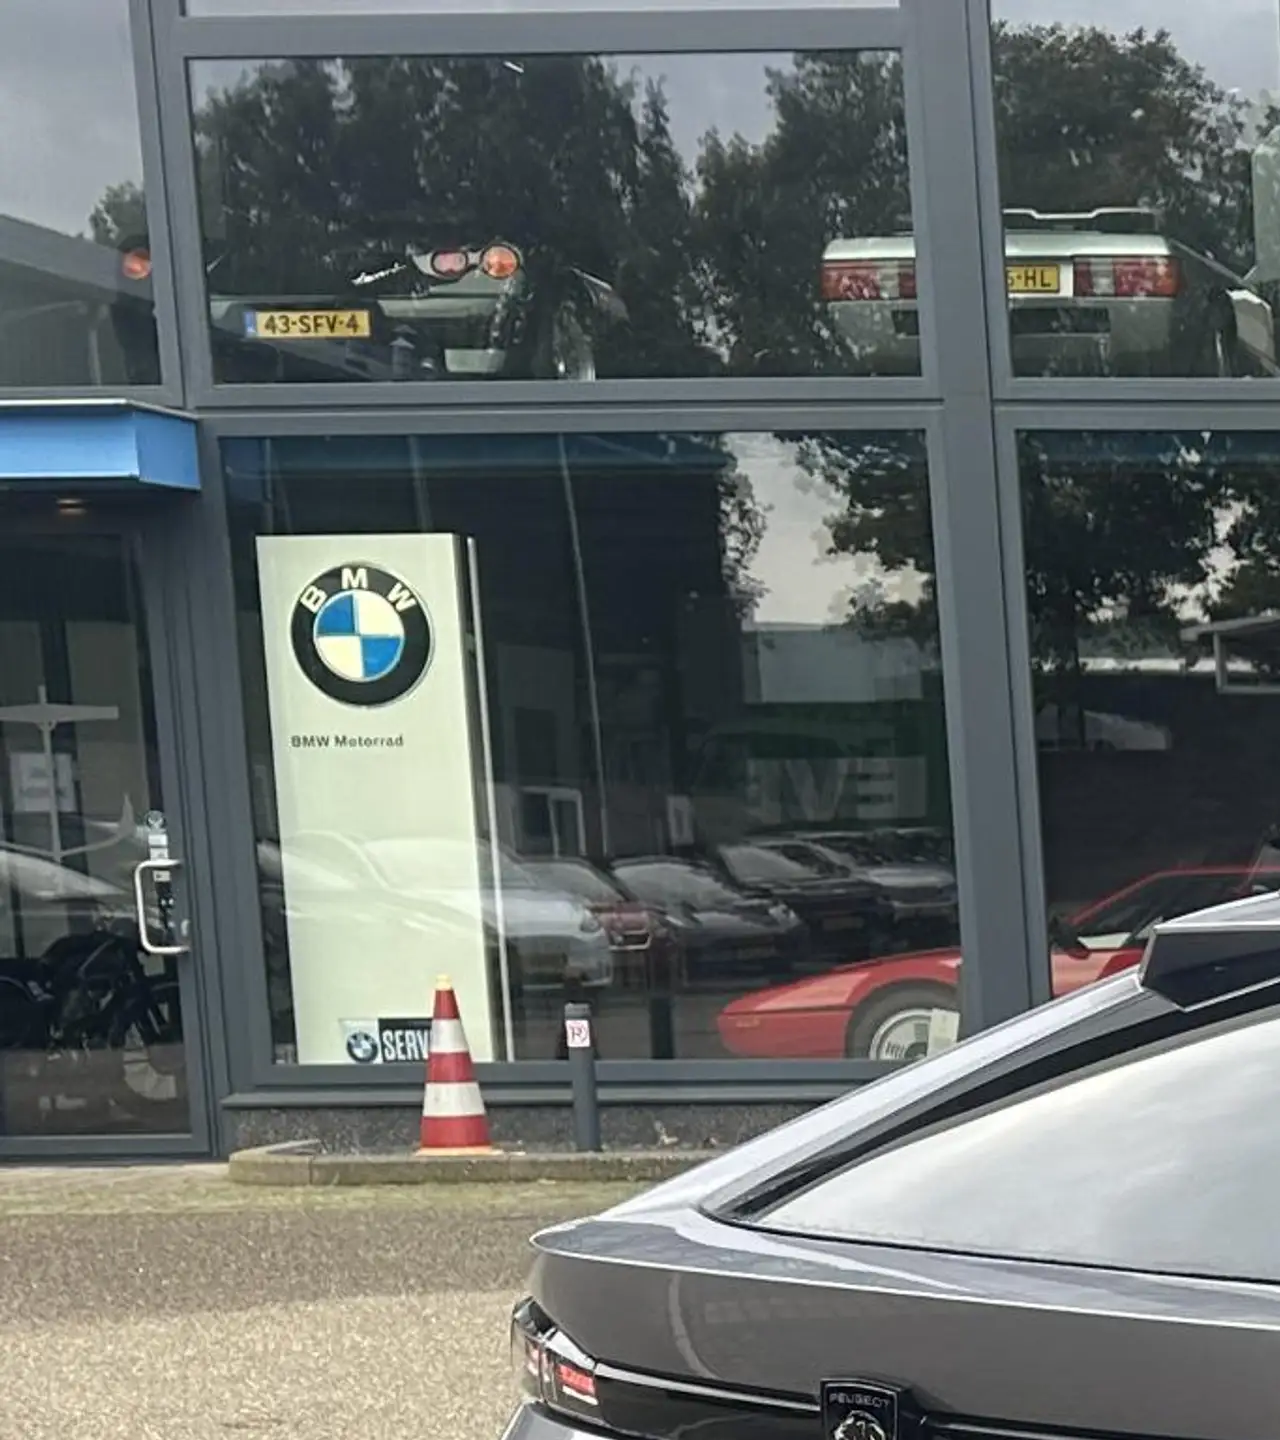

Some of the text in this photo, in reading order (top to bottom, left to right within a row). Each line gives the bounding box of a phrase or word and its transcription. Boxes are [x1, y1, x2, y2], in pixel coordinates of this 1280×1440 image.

[264, 314, 359, 334] 43-SFV-4
[300, 567, 417, 614] BMW
[290, 734, 404, 749] BMW Motorrad
[829, 1391, 891, 1408] PEUGEOT
